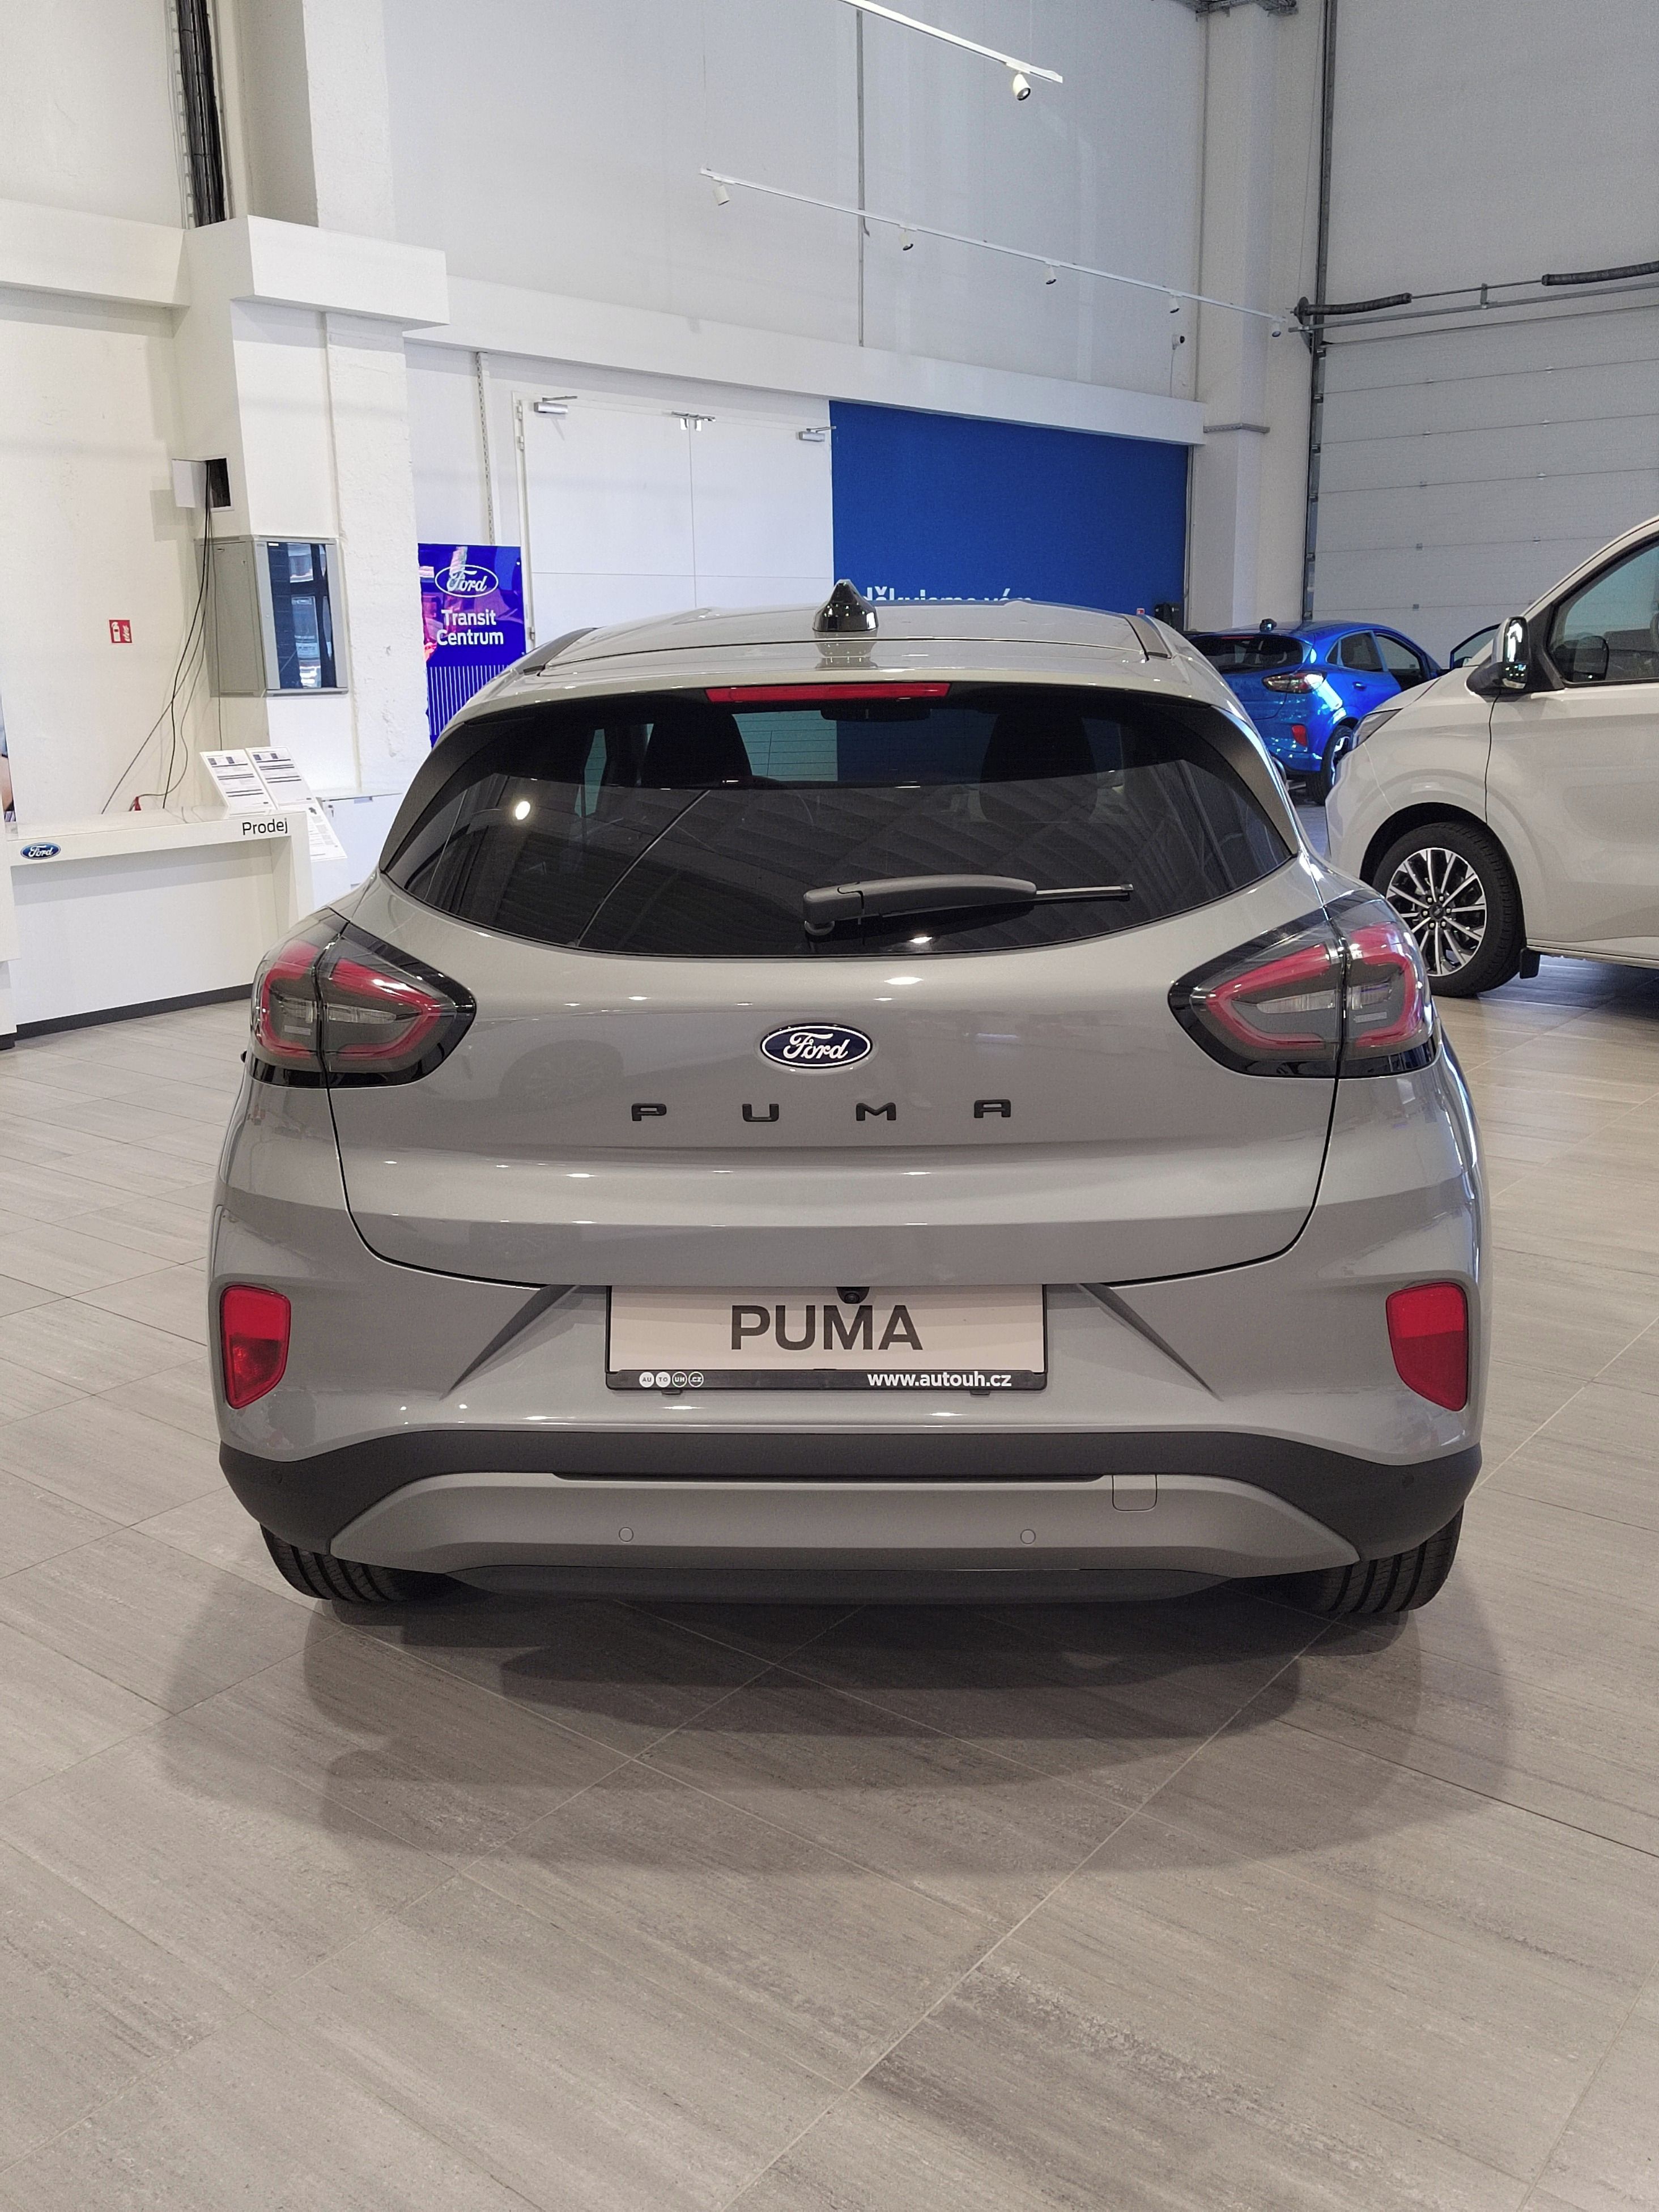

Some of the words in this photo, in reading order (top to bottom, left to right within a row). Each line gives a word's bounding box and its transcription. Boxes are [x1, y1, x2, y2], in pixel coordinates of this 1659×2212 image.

[446, 569, 487, 592] Ford
[441, 609, 496, 626] Transit
[436, 629, 504, 646] Centrum
[242, 818, 288, 836] Prodej
[28, 845, 54, 857] Ford
[782, 1032, 850, 1059] Ford
[631, 1099, 1011, 1122] PUMA
[730, 1304, 924, 1351] PUMA
[867, 1371, 1013, 1387] www.autouh.cz
